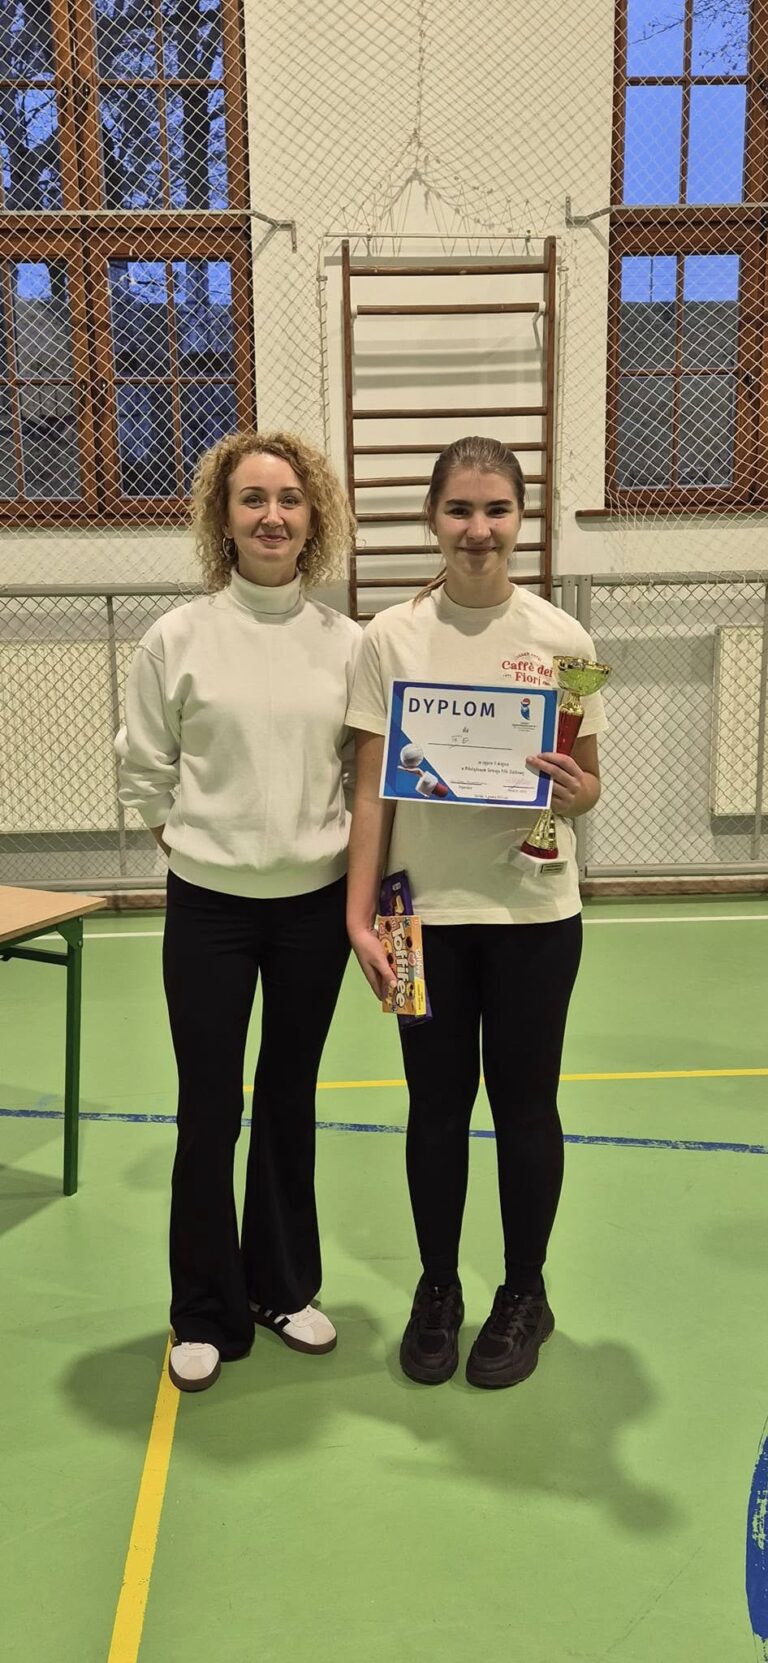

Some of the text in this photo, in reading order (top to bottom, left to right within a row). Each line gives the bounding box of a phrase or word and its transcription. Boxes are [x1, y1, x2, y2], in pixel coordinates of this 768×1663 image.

[501, 660, 553, 677] Caffè dei
[515, 671, 541, 686] Fiori
[408, 697, 496, 718] DYPLOM
[391, 922, 409, 1008] Toffifee
